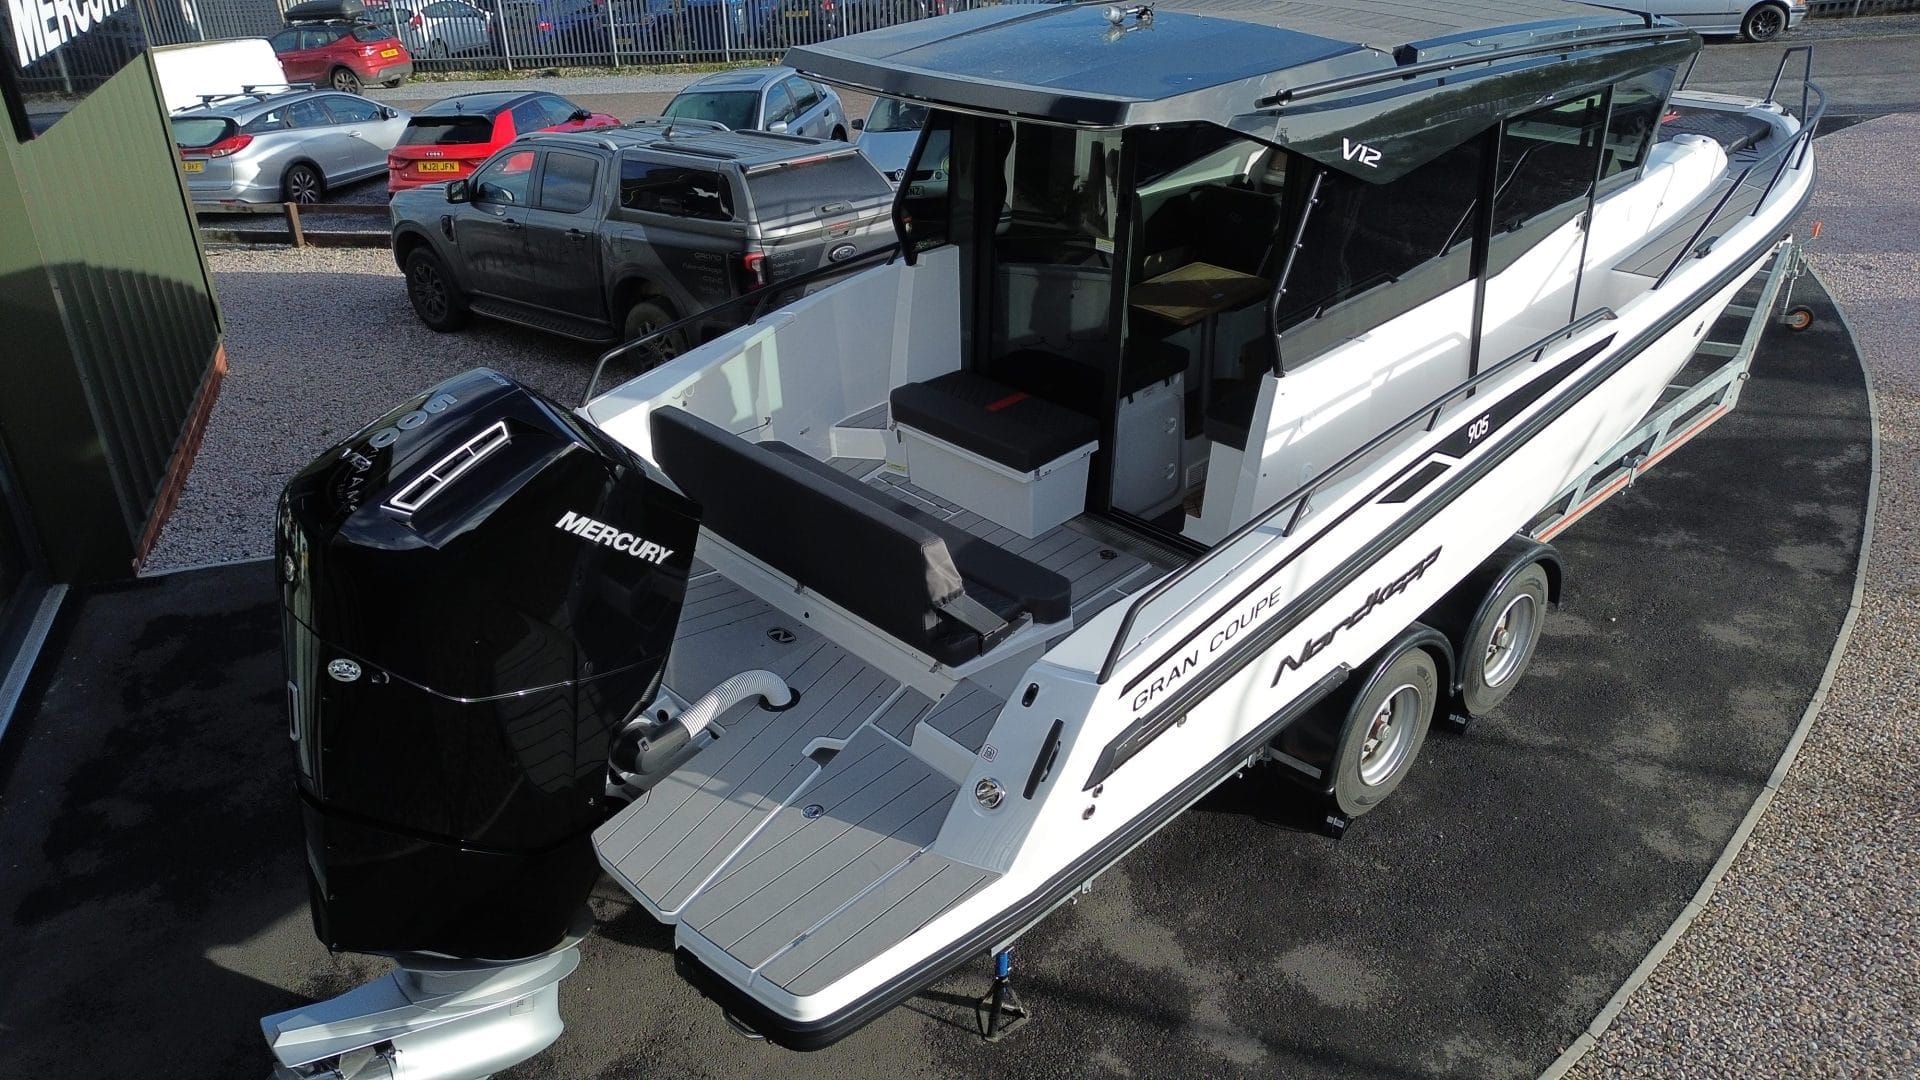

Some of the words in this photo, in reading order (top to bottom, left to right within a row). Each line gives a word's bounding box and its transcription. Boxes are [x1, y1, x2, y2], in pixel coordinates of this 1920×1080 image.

[1343, 137, 1382, 168] V12
[369, 394, 457, 448] 600
[1468, 413, 1490, 443] 905
[555, 510, 674, 565] MERCURY
[1270, 545, 1443, 688] Nordkapp
[1132, 650, 1199, 712] GRAN
[1209, 586, 1282, 652] COUPE
